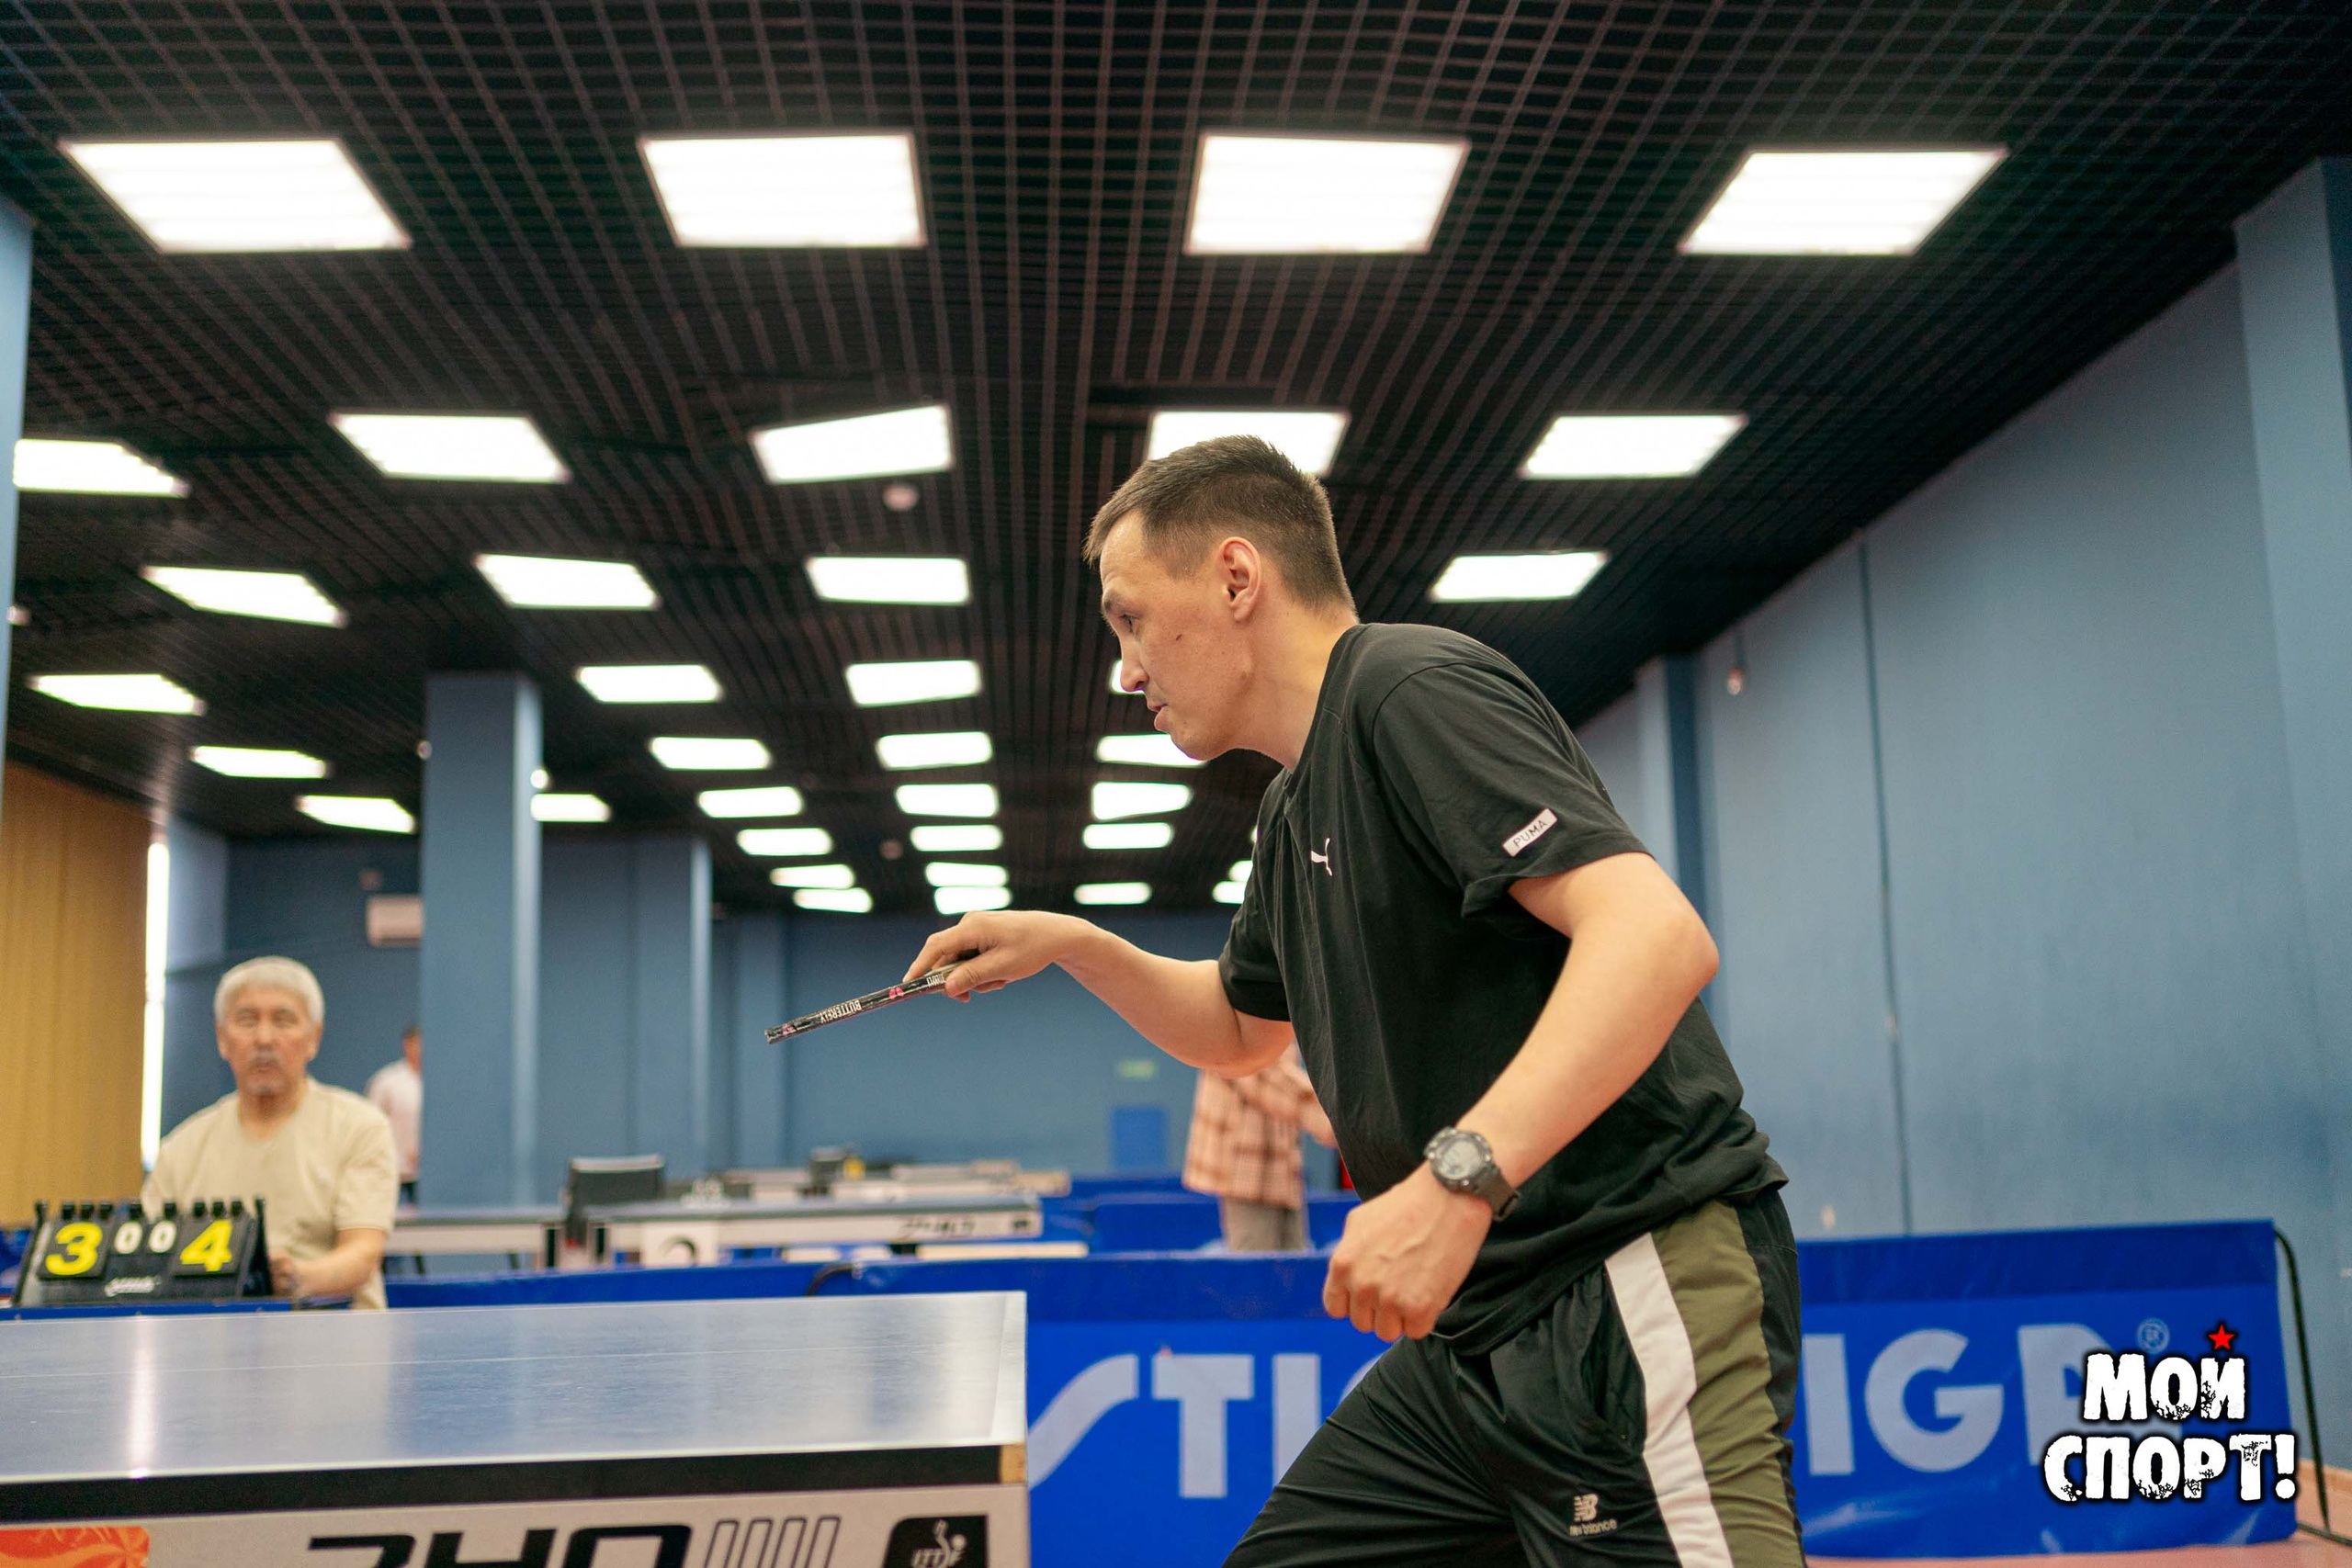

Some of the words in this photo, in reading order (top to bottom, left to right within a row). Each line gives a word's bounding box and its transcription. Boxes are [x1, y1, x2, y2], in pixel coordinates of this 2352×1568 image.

[1512, 819, 1548, 848] PUMA
[820, 999, 863, 1023] BUTTERFLY
[46, 1222, 102, 1276] 3
[180, 1219, 232, 1272] 4
